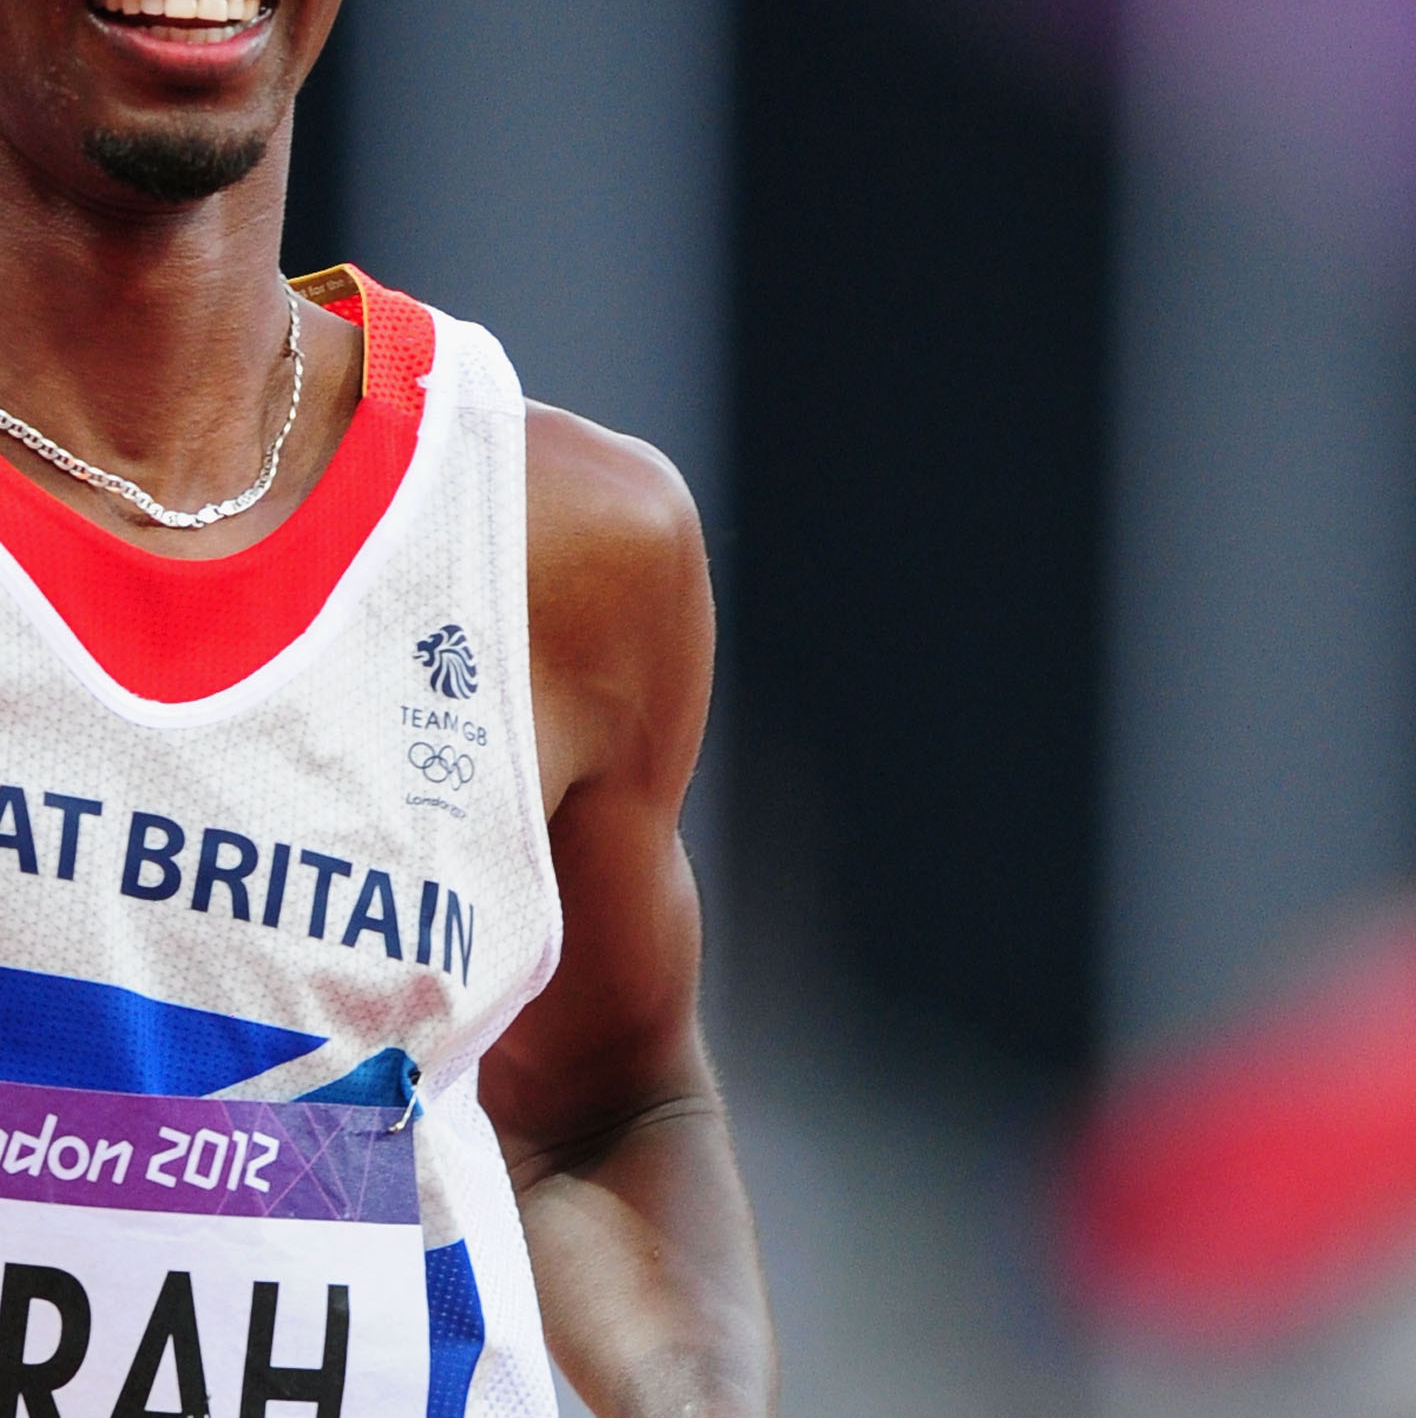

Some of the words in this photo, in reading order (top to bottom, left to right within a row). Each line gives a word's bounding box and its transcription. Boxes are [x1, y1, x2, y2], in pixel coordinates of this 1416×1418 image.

[462, 721, 488, 747] GB
[120, 811, 474, 988] BRITAIN
[146, 1126, 281, 1193] 2012
